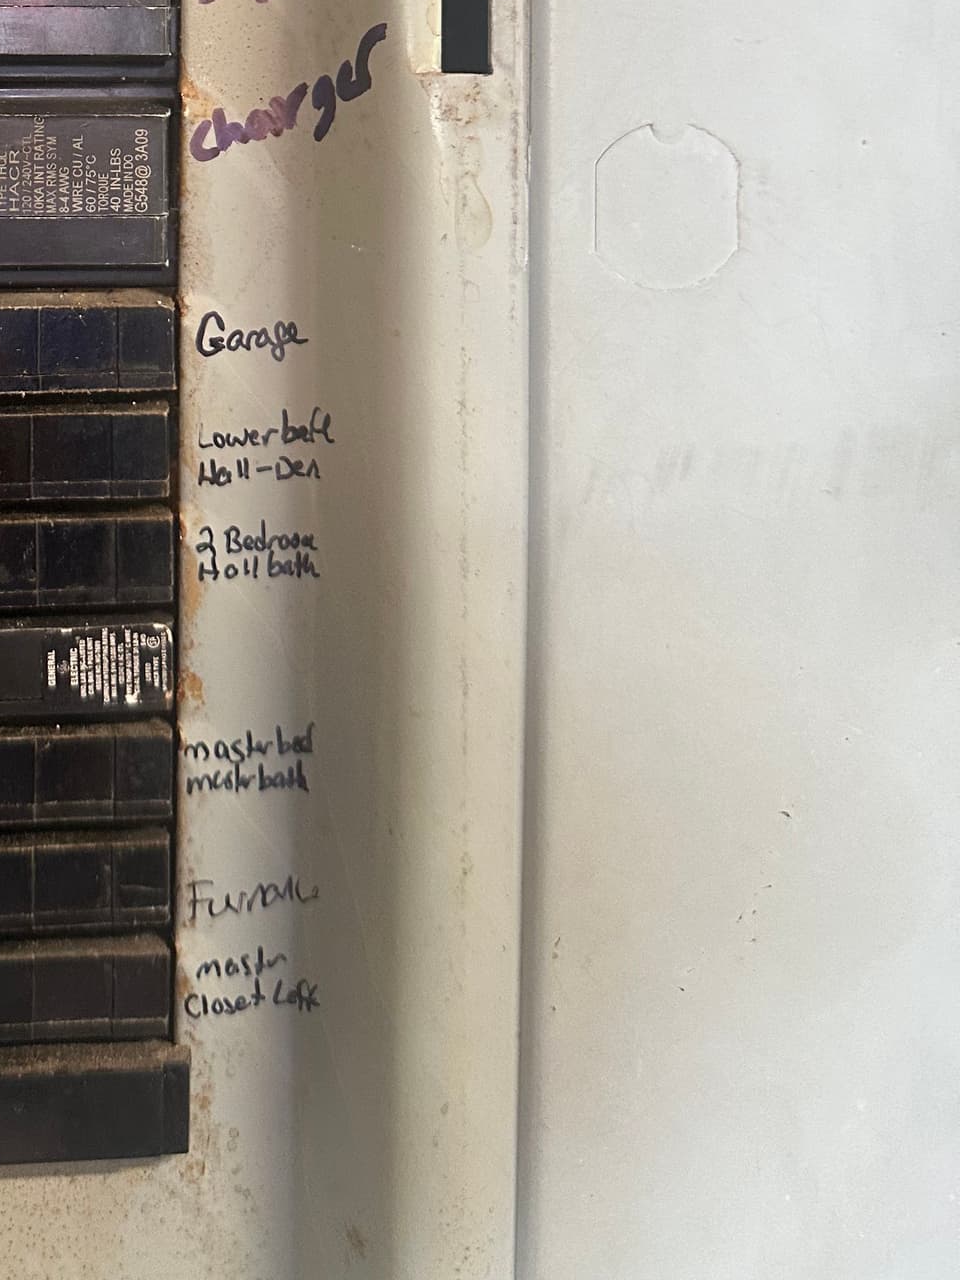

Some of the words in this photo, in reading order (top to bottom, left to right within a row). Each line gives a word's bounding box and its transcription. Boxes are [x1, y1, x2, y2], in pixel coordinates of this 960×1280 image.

[33, 117, 45, 160] RATING
[46, 136, 57, 160] SYM
[72, 134, 83, 150] AL
[135, 129, 148, 161] 3A09
[34, 164, 45, 184] INT
[47, 163, 57, 186] RMS
[72, 160, 83, 177] CU
[109, 147, 121, 190] IN-LBS
[123, 154, 133, 170] DO
[9, 150, 20, 212] HACR
[59, 167, 69, 193] AWG
[123, 171, 133, 182] IN
[23, 195, 33, 214] 120
[34, 187, 45, 214] 10KA
[47, 190, 57, 213] MAX
[60, 197, 70, 213] 8-4
[72, 181, 83, 213] WIRE
[86, 197, 96, 213] 60
[98, 173, 109, 212] TORQUE
[110, 197, 121, 212] 40
[123, 183, 134, 212] MADE
[195, 310, 310, 362] Garage
[48, 650, 56, 686] GENERAL
[70, 648, 78, 686] ELECTRIC
